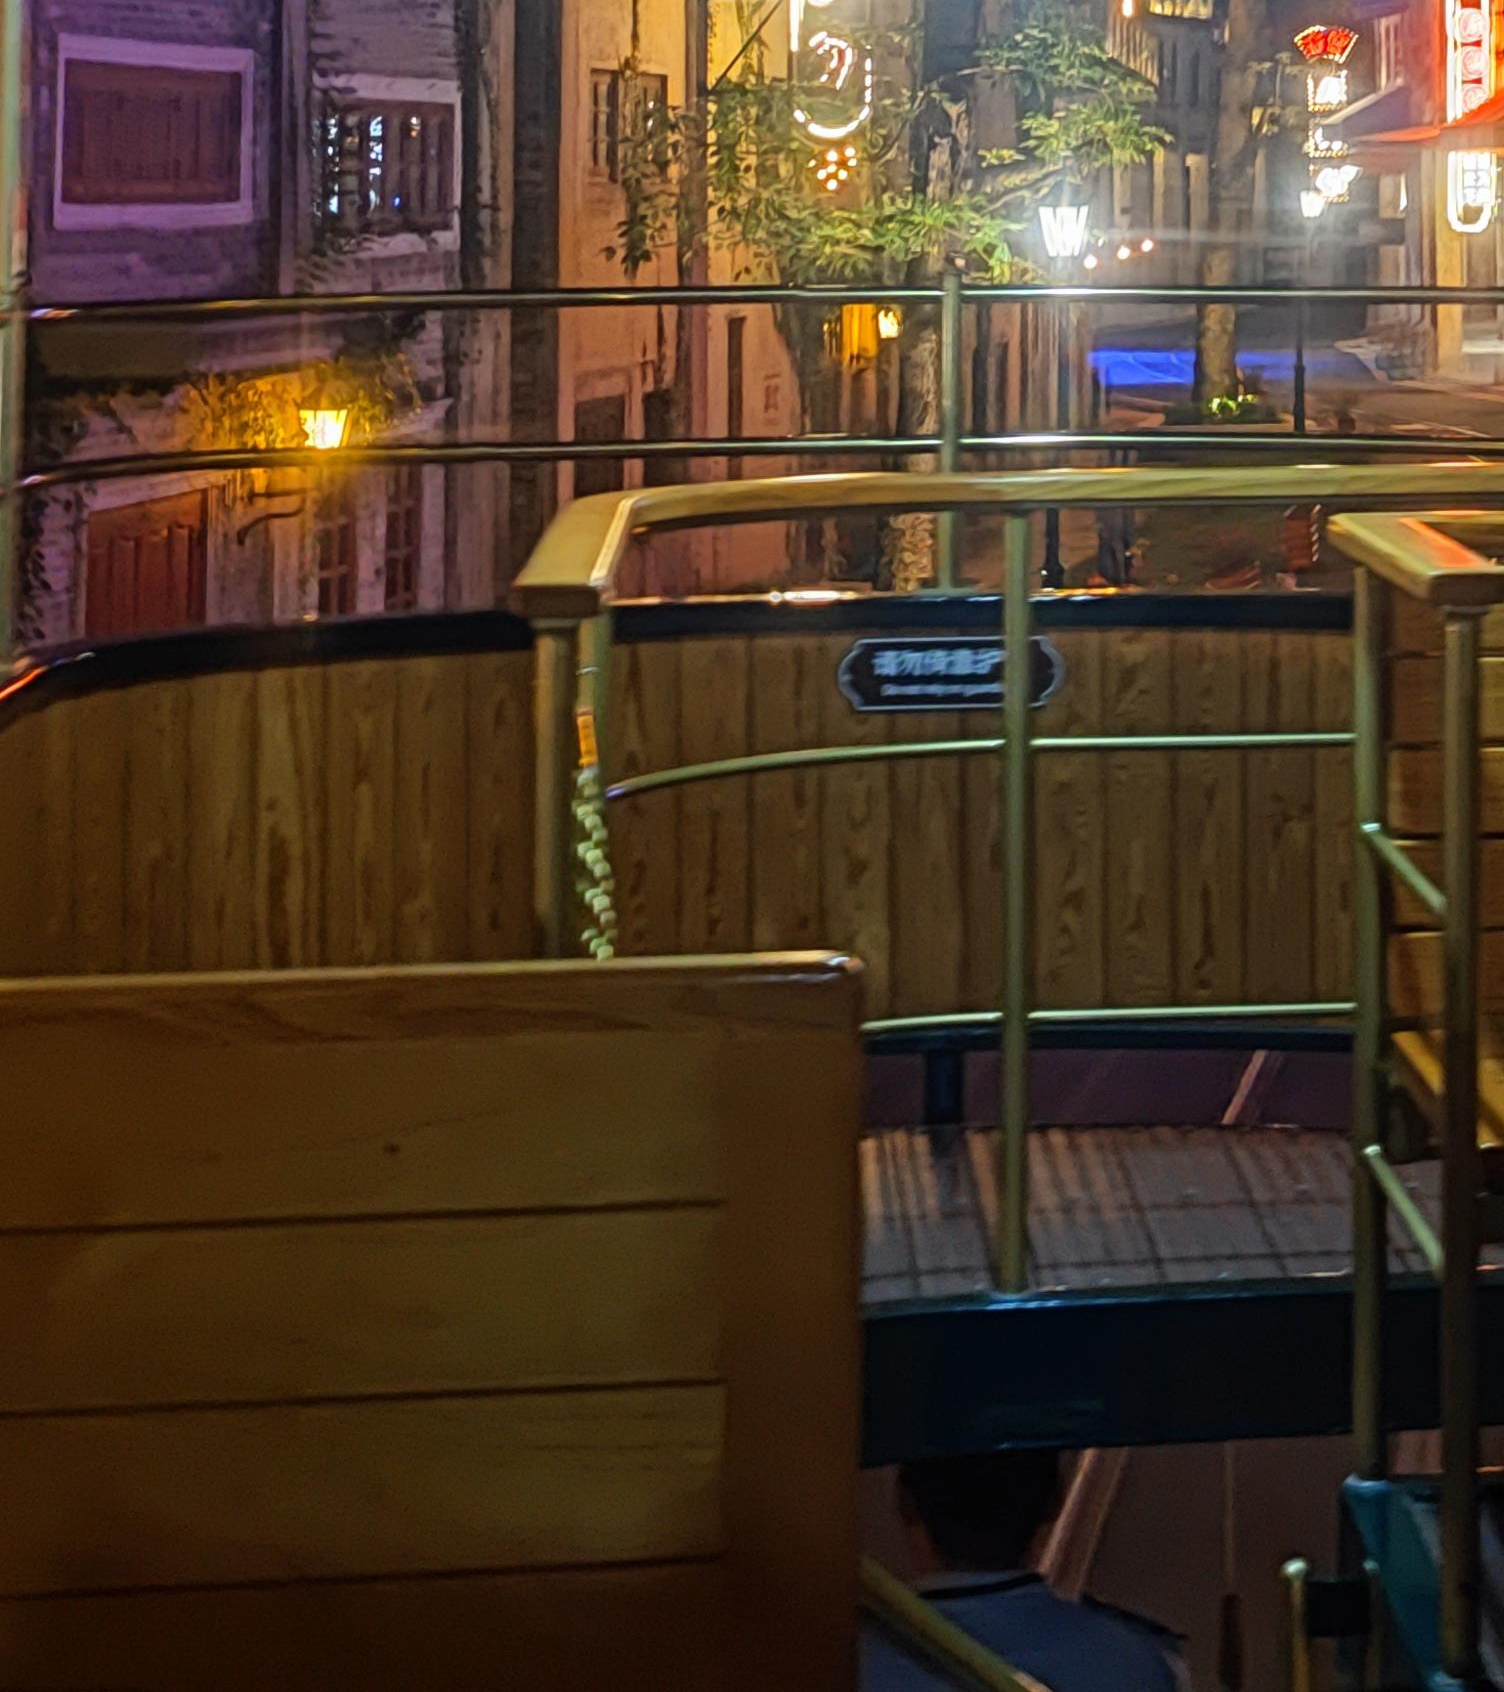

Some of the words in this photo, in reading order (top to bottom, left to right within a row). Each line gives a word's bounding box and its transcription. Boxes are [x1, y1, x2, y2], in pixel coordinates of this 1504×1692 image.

[872, 649, 1006, 676] 请勿倚靠护
